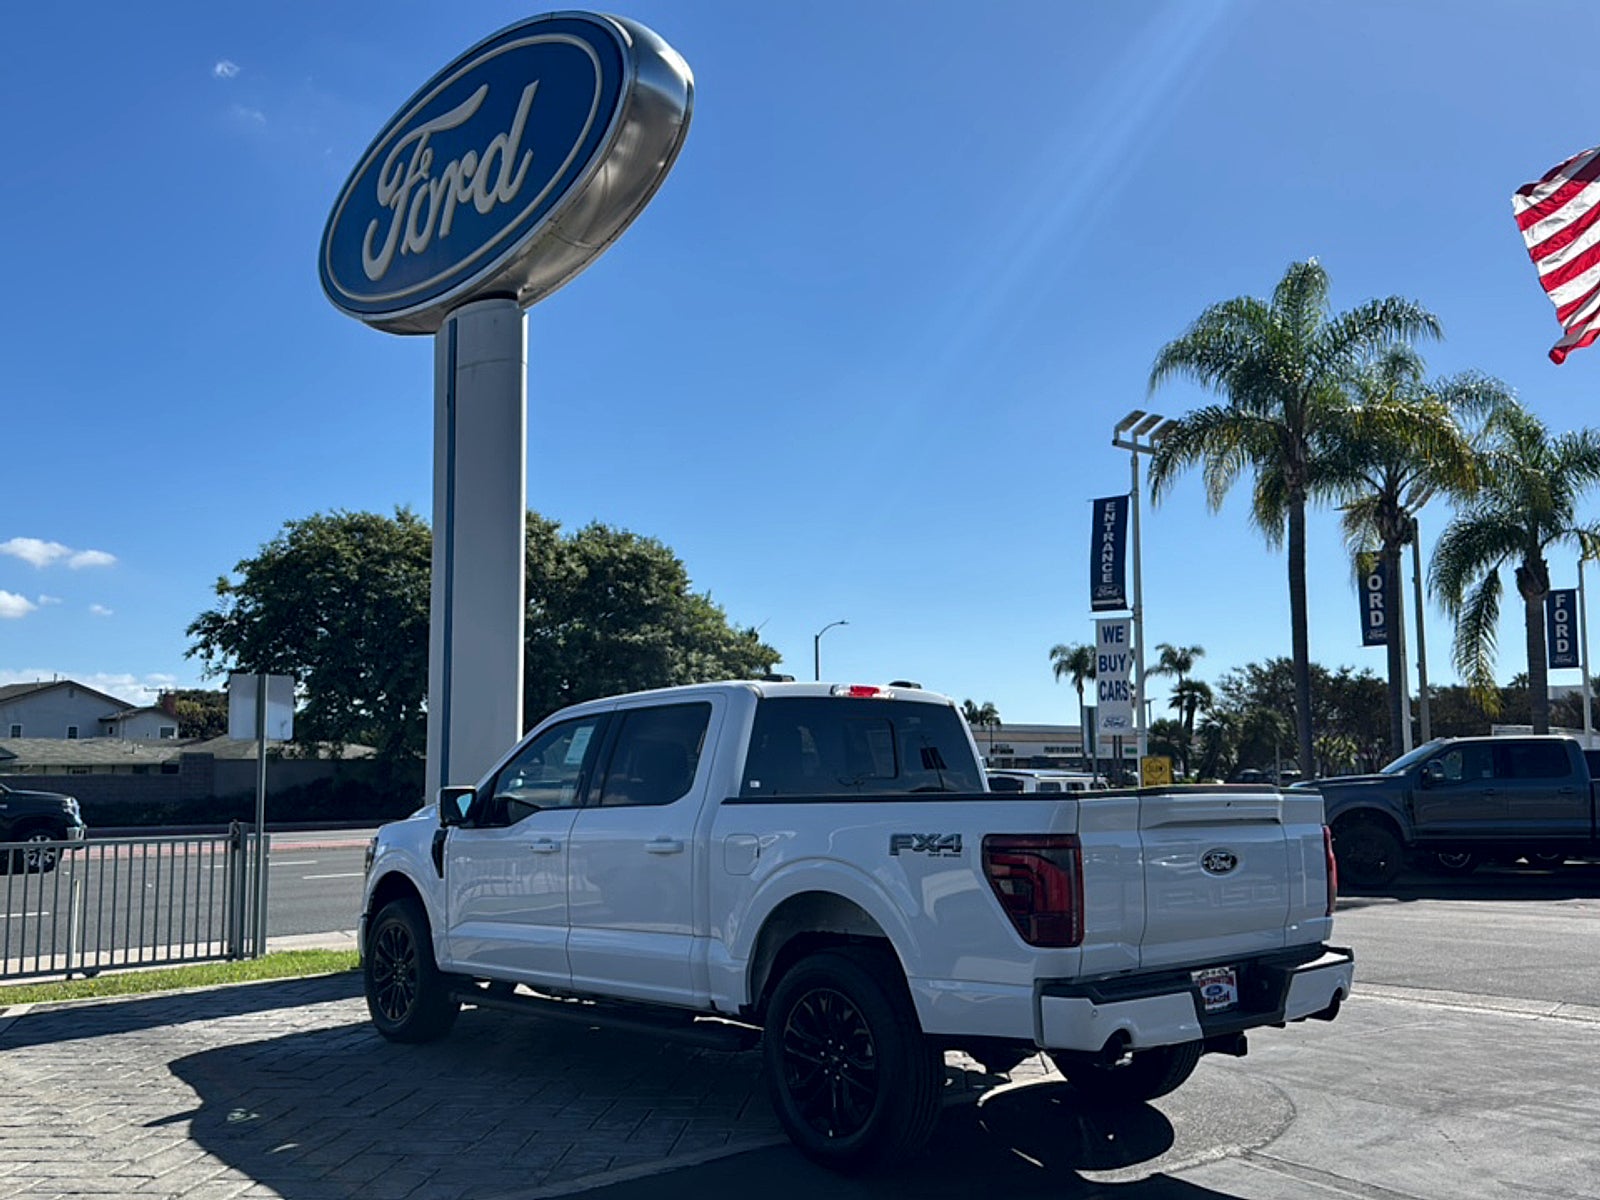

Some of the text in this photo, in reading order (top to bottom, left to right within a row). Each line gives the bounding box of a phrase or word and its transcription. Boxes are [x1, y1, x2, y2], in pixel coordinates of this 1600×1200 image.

[362, 79, 539, 281] Ford
[1102, 502, 1116, 583] ENTRANCE
[1102, 625, 1124, 643] WE
[1555, 593, 1569, 653] FORD
[1099, 654, 1126, 672] BUY
[1100, 680, 1129, 701] CARS
[889, 833, 962, 856] FX4
[1203, 852, 1234, 870] Ford
